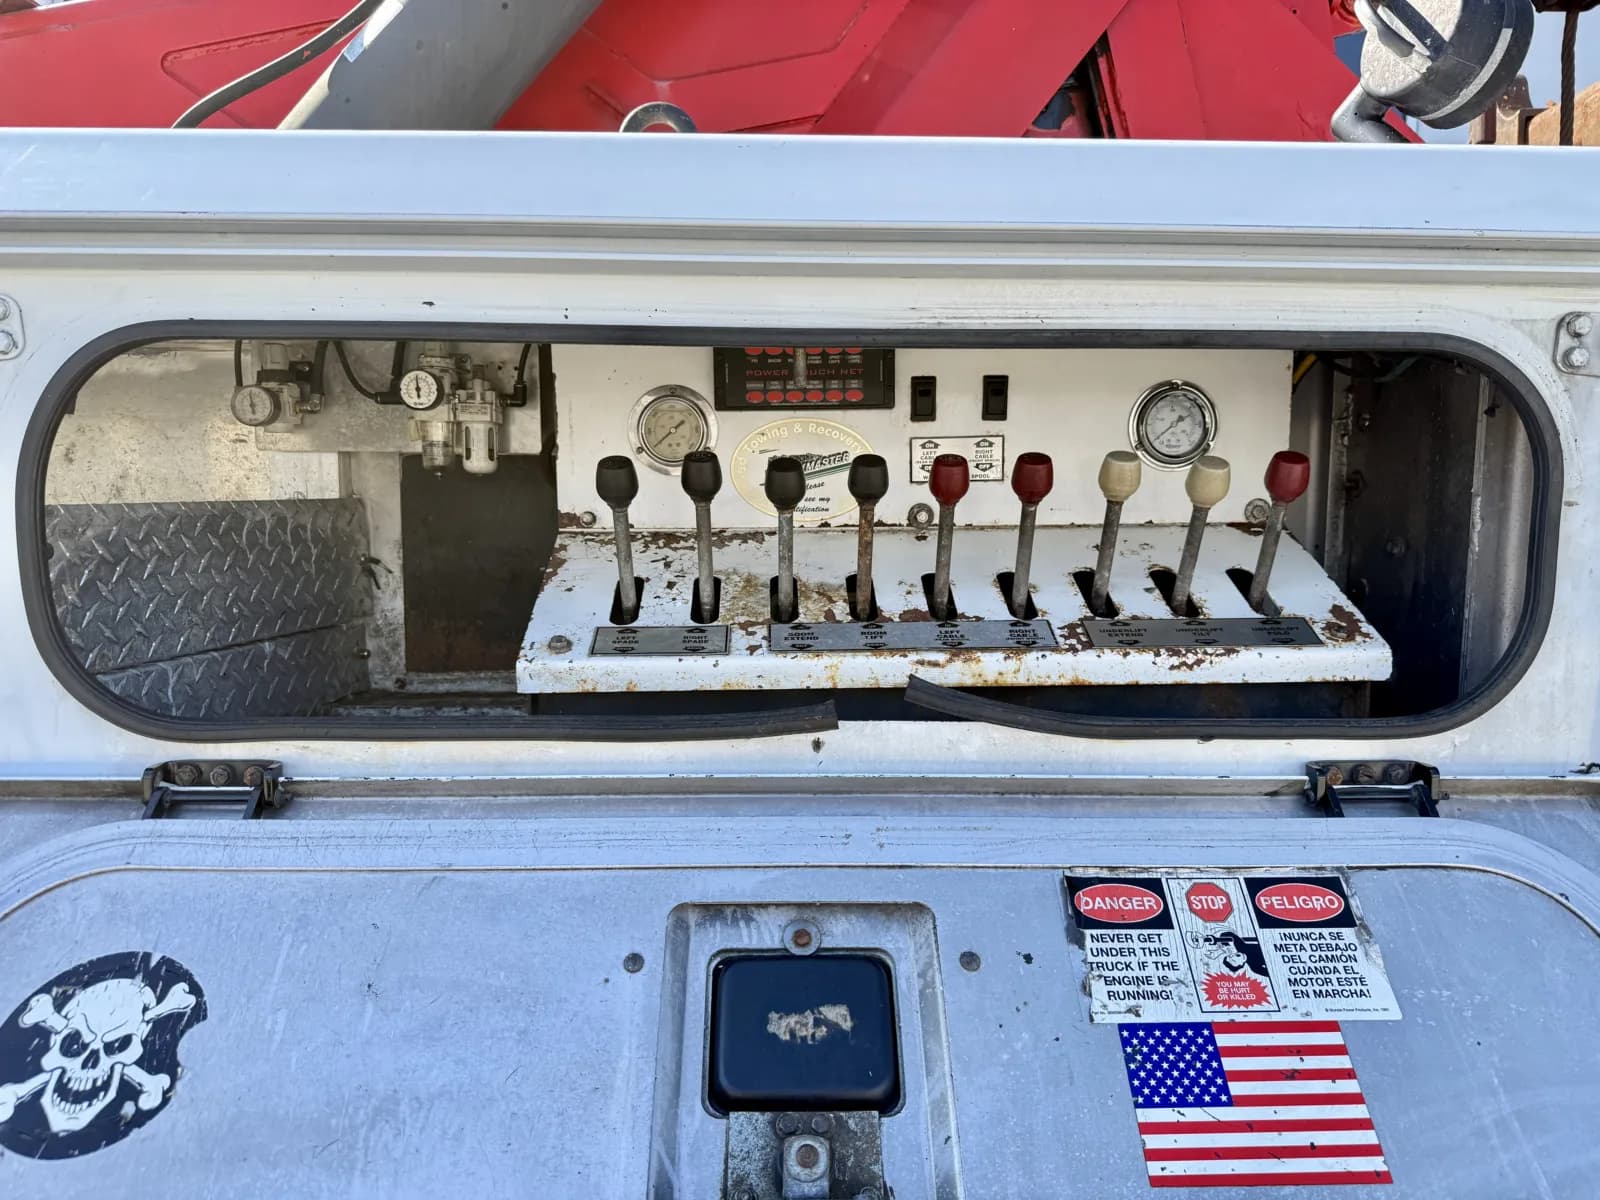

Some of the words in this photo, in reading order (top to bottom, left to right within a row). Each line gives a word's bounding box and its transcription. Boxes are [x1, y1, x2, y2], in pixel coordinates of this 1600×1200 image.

[743, 425, 788, 452] Towing
[793, 423, 803, 433] &
[806, 481, 825, 490] lease
[1082, 896, 1157, 910] DANGER
[1190, 895, 1226, 910] STOP
[1260, 896, 1339, 910] PELIGRO
[1090, 933, 1134, 943] NEVER
[1137, 933, 1163, 943] GET
[1328, 932, 1345, 941] SE
[1090, 947, 1137, 957] UNDER
[1139, 947, 1171, 957] THIS
[1273, 943, 1308, 952] META
[1309, 943, 1358, 952] DEBAJO
[1281, 954, 1307, 964] DEL
[1308, 951, 1358, 964] CAMIÓN
[1088, 961, 1135, 971] TRUCK
[1137, 961, 1149, 971] IF
[1152, 961, 1180, 971] THE
[1288, 965, 1342, 975] CUANDA
[1343, 965, 1360, 975] EL
[1104, 975, 1154, 986] ENGINE
[1157, 975, 1169, 986] IS
[1287, 977, 1334, 987] MOTOR
[1336, 974, 1369, 987] ESTÉ
[1107, 990, 1174, 1001] RUNNING!
[1292, 989, 1310, 999] EN
[1312, 988, 1372, 999] MARCHA!
